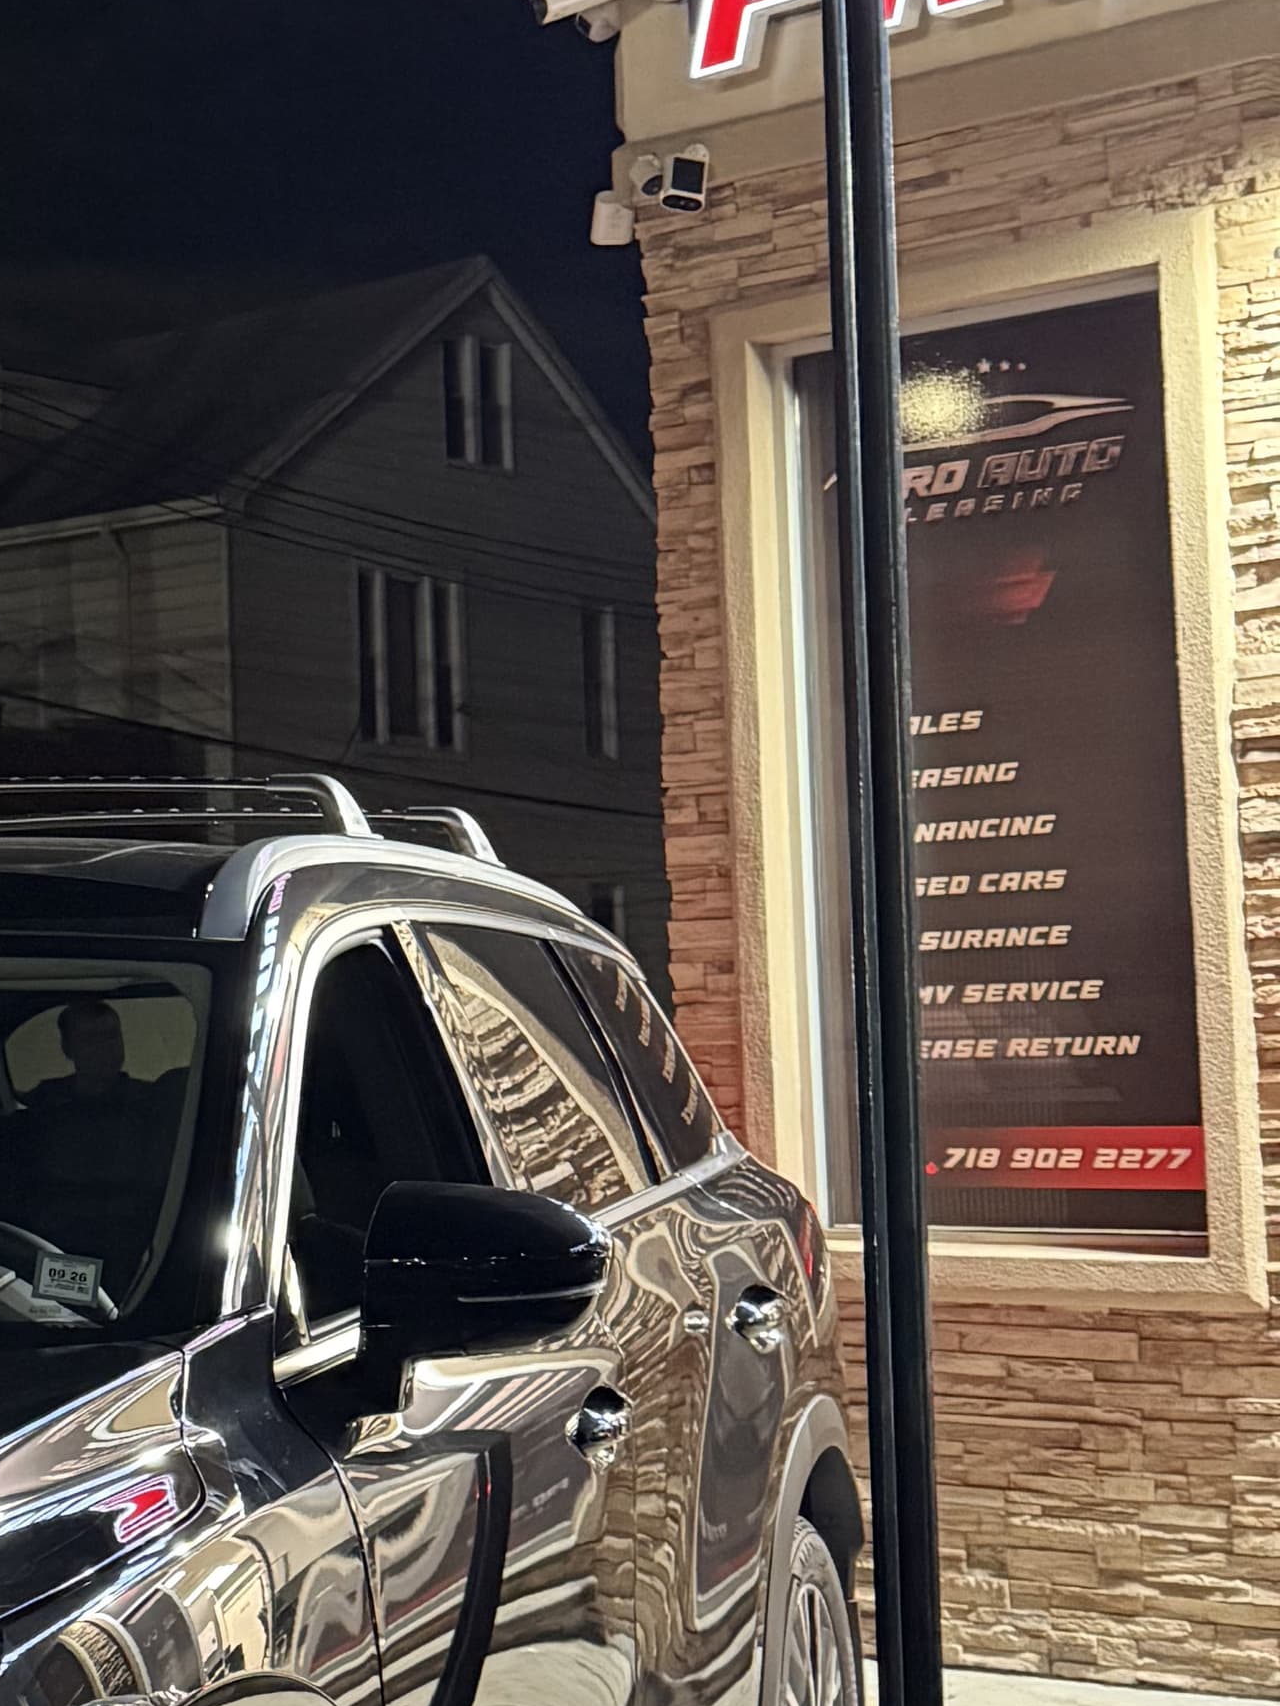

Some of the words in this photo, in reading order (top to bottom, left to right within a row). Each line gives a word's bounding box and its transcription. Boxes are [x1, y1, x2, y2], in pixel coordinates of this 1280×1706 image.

[901, 459, 970, 499] RO
[977, 436, 1126, 489] AUTO
[914, 814, 1056, 843] NANCING
[915, 875, 970, 897] SED
[978, 869, 1067, 893] CARS
[919, 925, 1071, 951] SURANCE
[919, 984, 954, 1005] MV
[961, 979, 1104, 1004] SERVICE
[920, 1038, 997, 1059] EASE
[1005, 1035, 1140, 1057] RETURN
[943, 1148, 1000, 1169] 718
[1010, 1148, 1083, 1169] 902
[1092, 1148, 1192, 1169] 2277
[70, 1271, 87, 1282] 26
